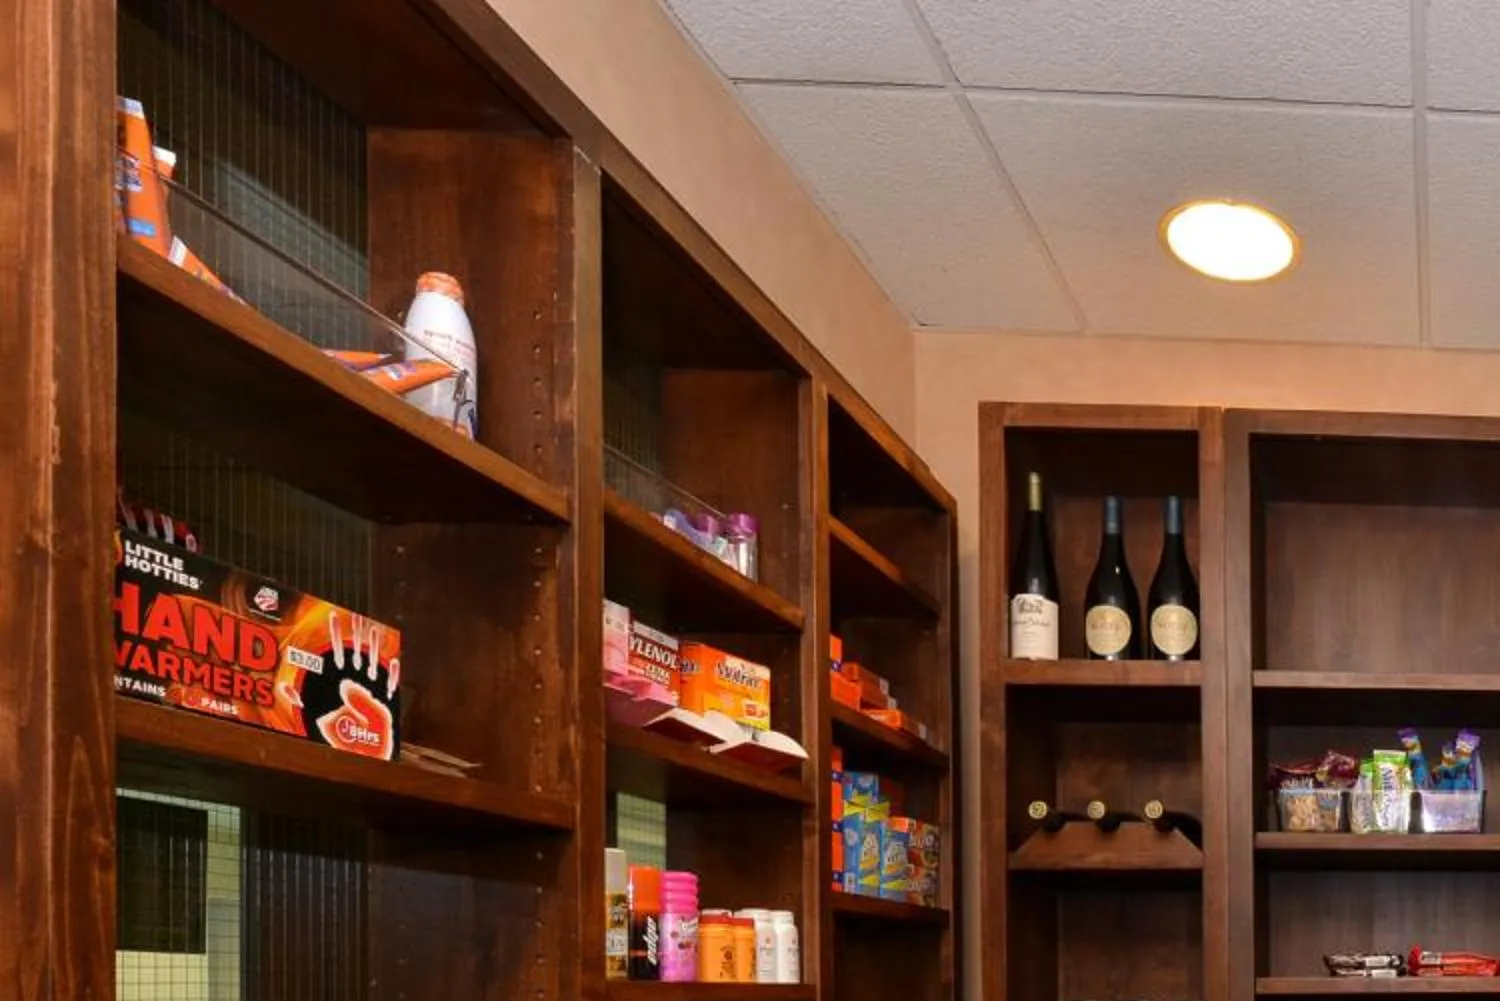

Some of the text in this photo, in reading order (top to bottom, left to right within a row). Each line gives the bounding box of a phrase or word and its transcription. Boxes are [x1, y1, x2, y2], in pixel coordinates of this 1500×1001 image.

[124, 539, 184, 571] LITTLE
[124, 554, 200, 590] HOTTIES
[114, 581, 278, 672] HAND
[629, 633, 679, 669] YLENOL
[200, 696, 239, 715] PAIRS
